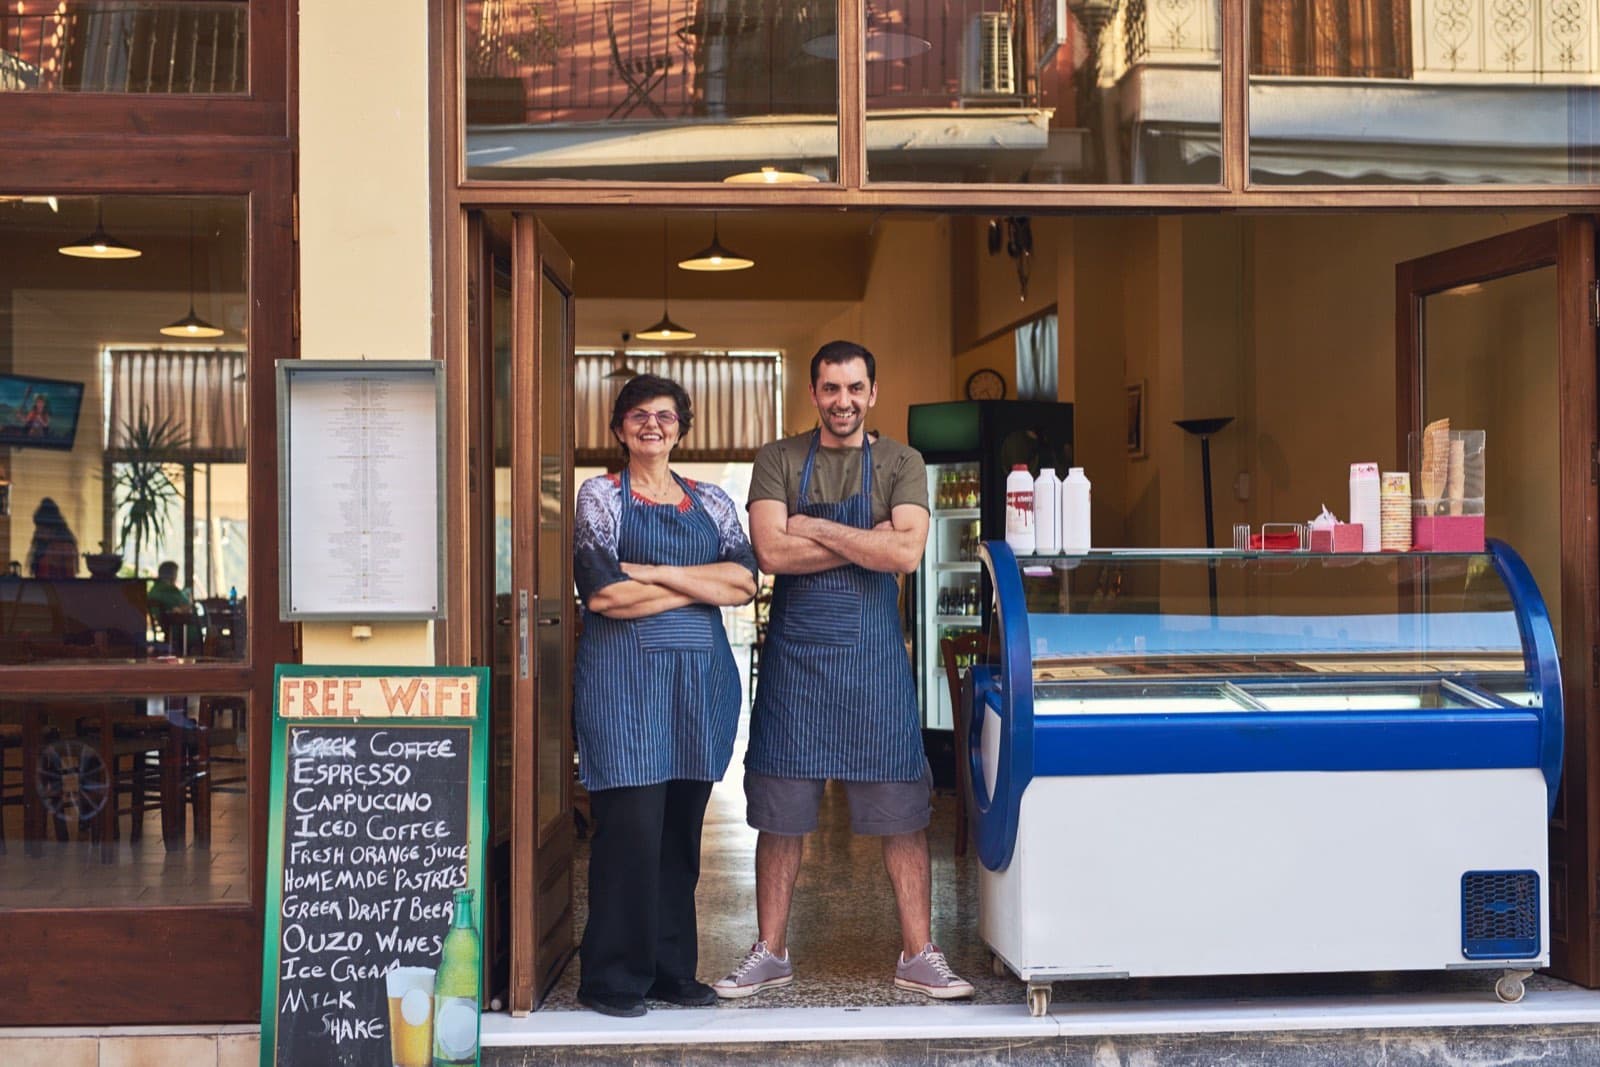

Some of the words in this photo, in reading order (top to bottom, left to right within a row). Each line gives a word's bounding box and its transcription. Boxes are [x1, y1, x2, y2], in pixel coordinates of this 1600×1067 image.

[282, 680, 361, 716] FREE
[379, 678, 471, 716] WiFi
[369, 731, 457, 762] COFFEE
[293, 757, 412, 786] ESPRESSO
[292, 787, 432, 813] CAPPUCCINO
[293, 813, 357, 838] ICED
[366, 815, 451, 841] COFFEE
[290, 841, 344, 865] FRESH
[350, 845, 420, 866] ORANGE
[423, 842, 468, 867] JUICE
[284, 867, 388, 893] HOMEMADE
[348, 896, 406, 922] DRAFT
[375, 926, 443, 957] WINES
[281, 988, 356, 1014] MILK
[321, 1012, 385, 1045] SHAKE
